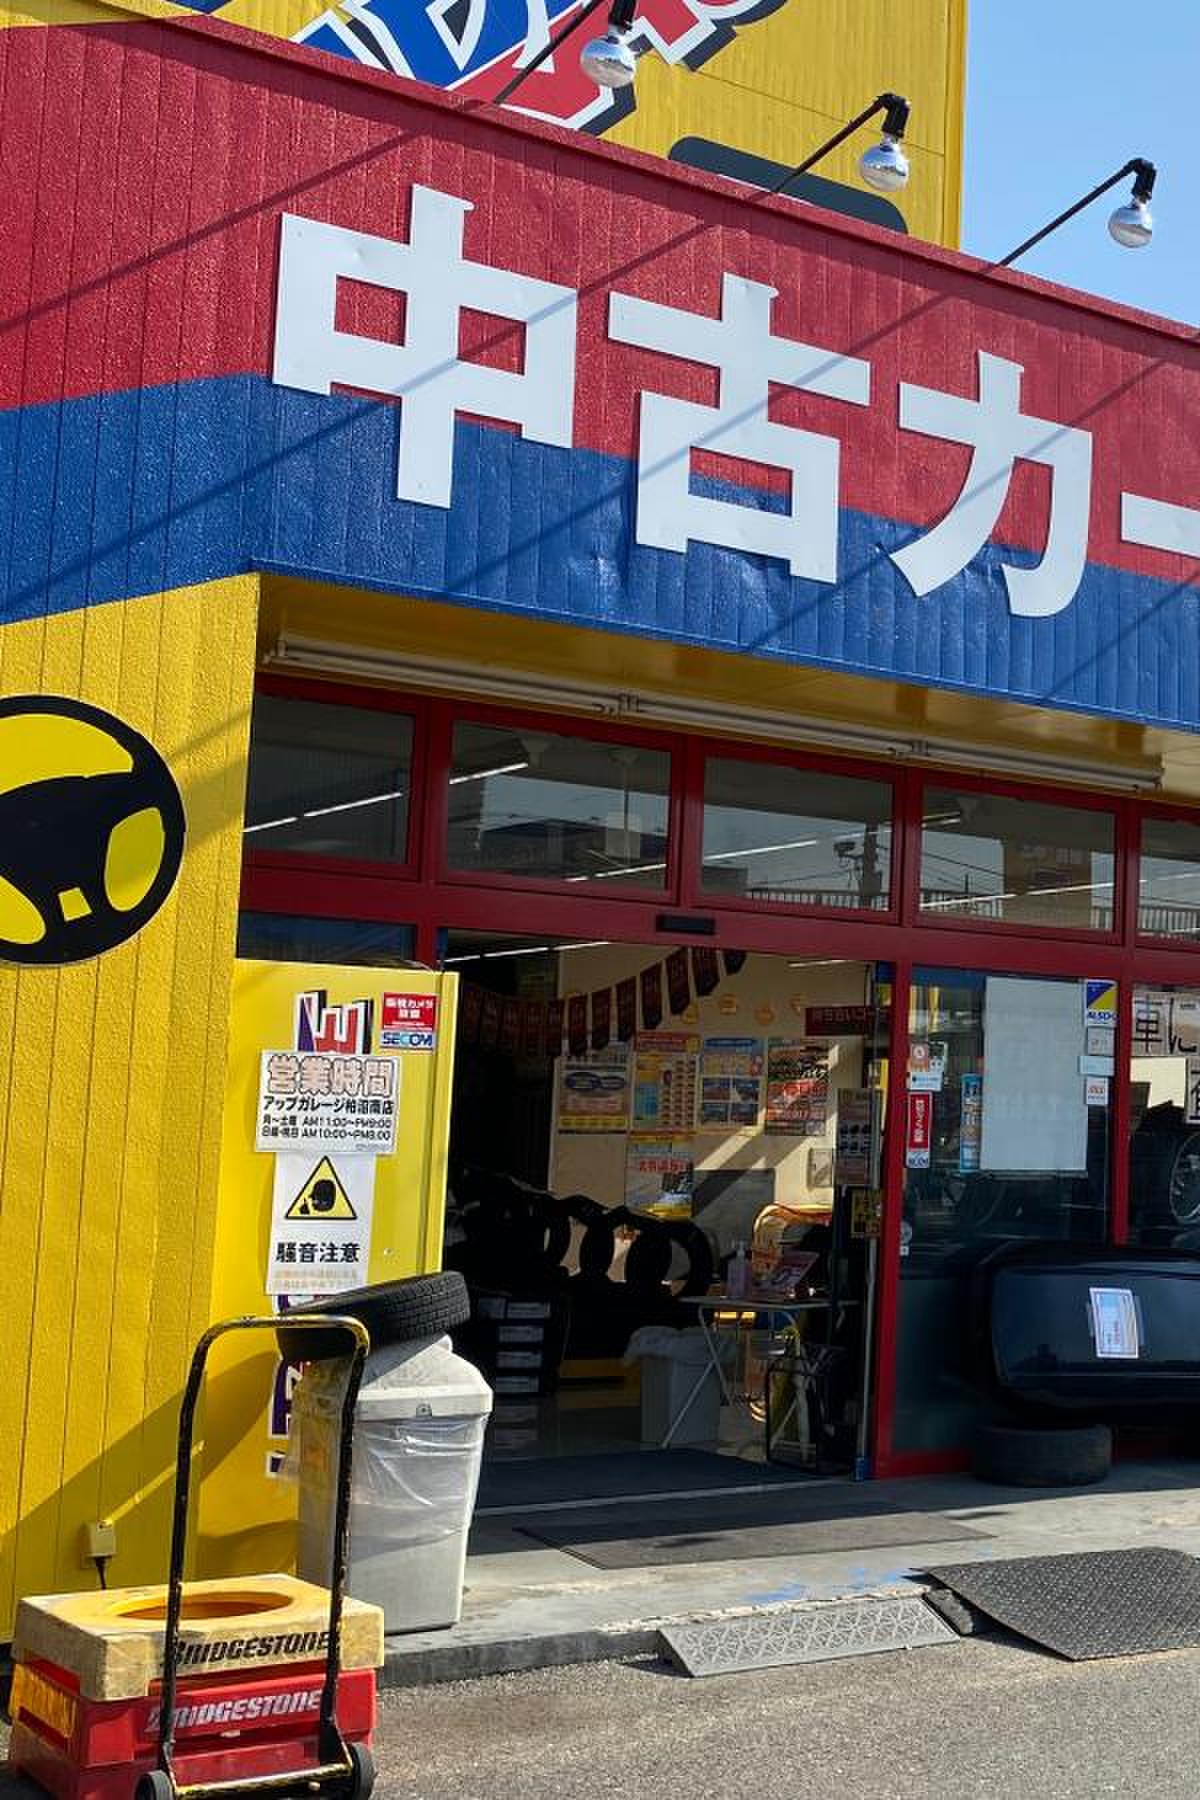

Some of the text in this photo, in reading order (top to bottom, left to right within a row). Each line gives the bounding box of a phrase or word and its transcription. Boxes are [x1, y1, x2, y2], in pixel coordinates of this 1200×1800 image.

[382, 1031, 433, 1047] SECOM
[268, 1054, 394, 1099] 営業時間
[275, 1241, 361, 1264] 騒音注意
